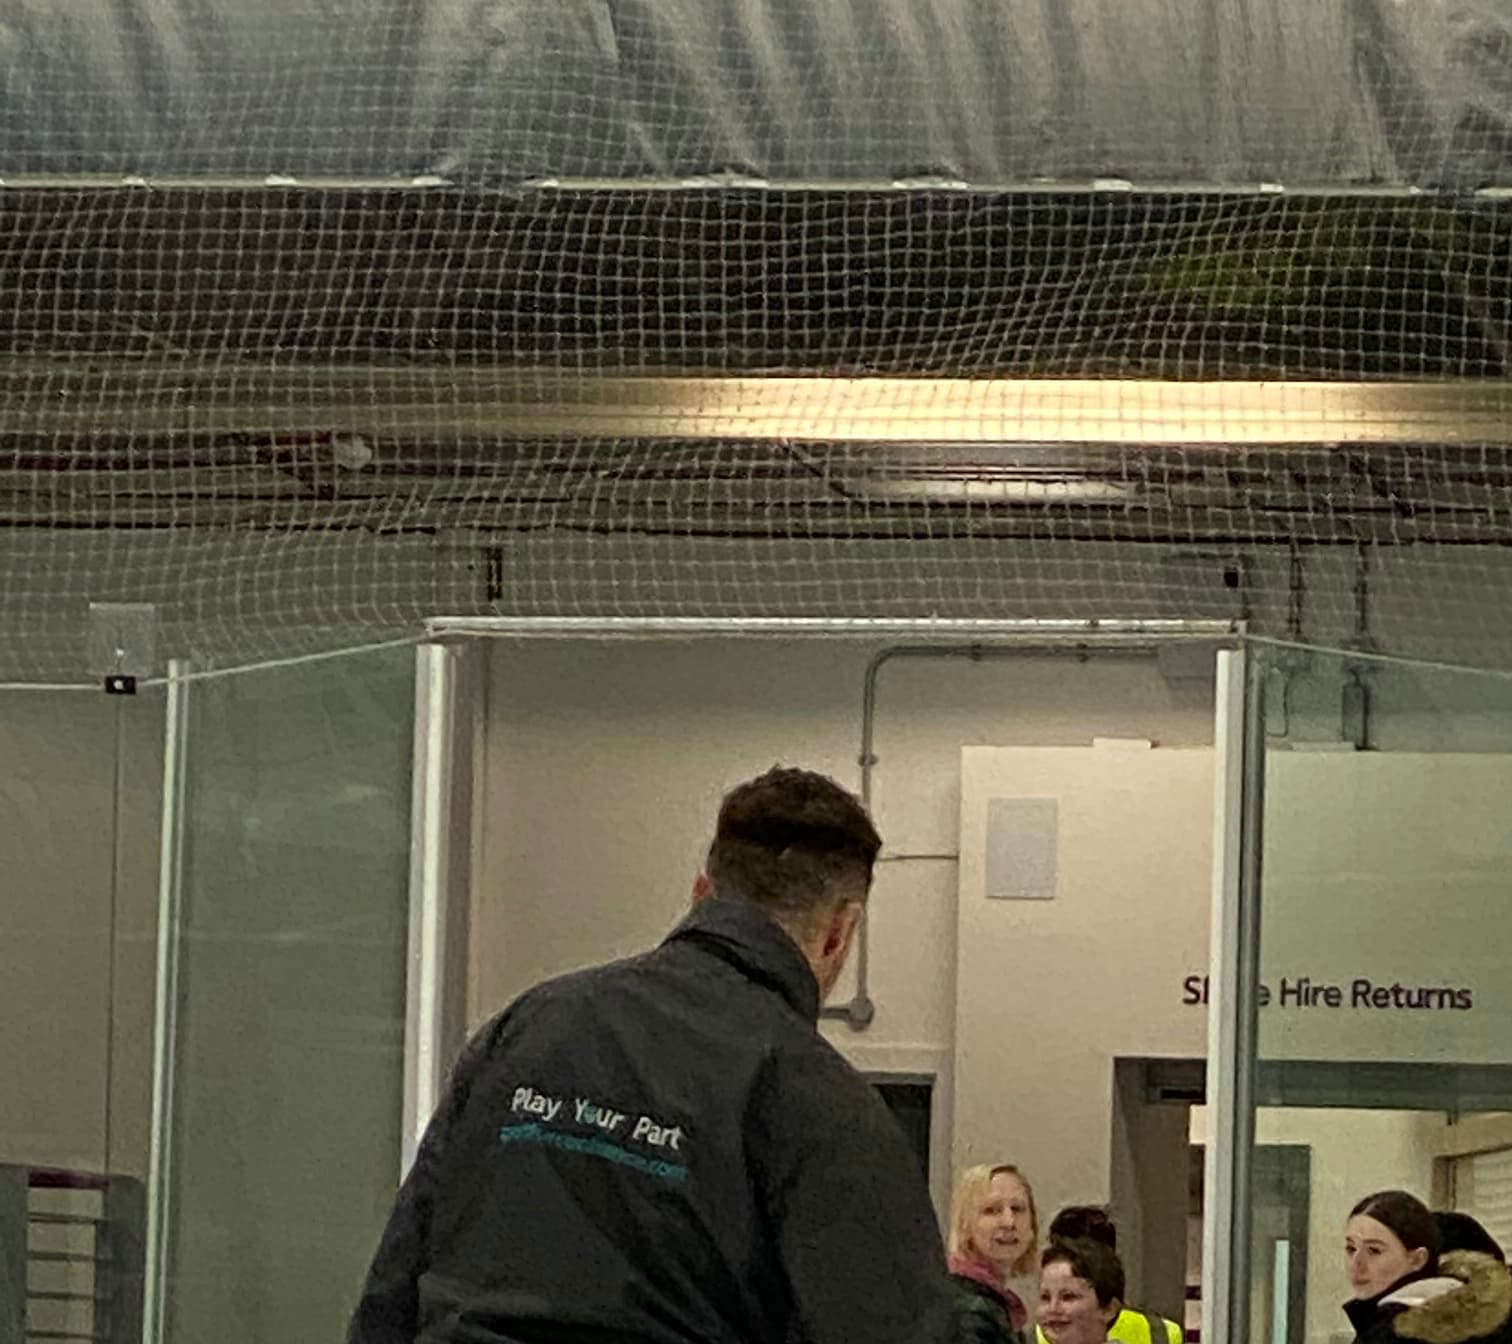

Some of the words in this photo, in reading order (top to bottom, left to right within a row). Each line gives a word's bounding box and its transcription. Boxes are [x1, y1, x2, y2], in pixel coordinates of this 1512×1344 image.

[1279, 977, 1343, 1009] Hire
[1351, 979, 1473, 1010] Returns
[511, 1087, 563, 1122] Play
[574, 1098, 625, 1131] Your
[632, 1116, 685, 1150] Part
